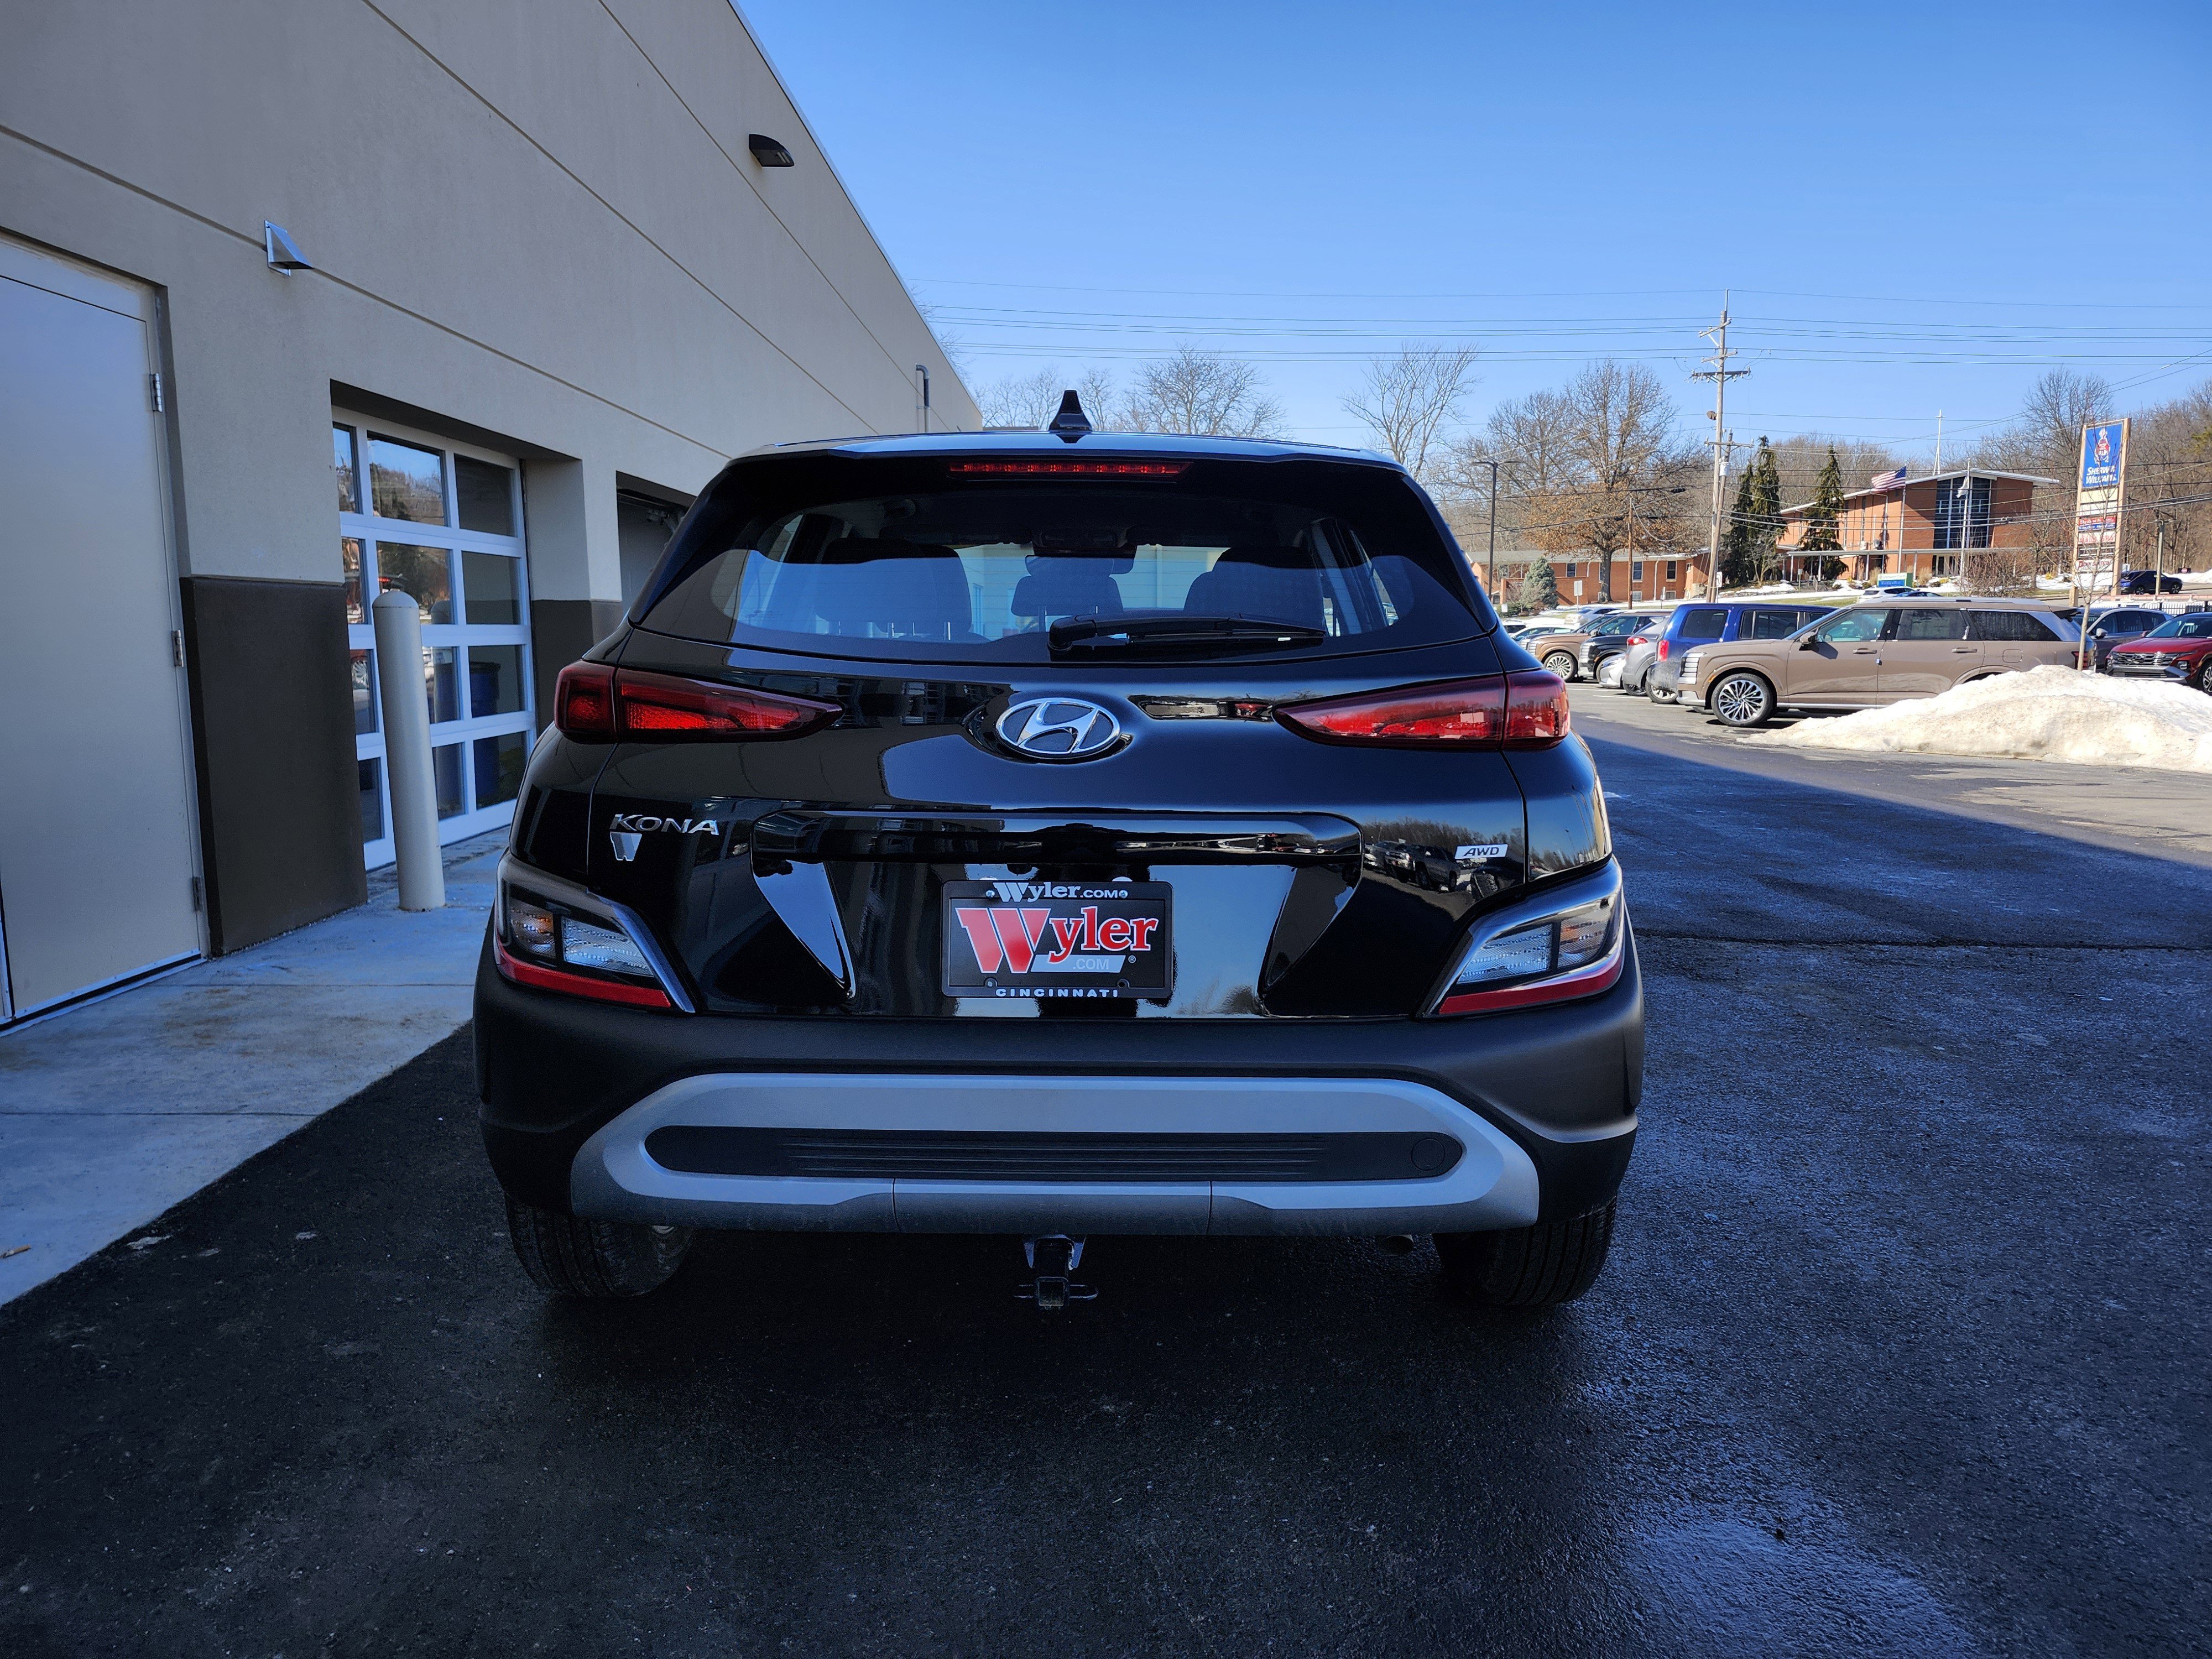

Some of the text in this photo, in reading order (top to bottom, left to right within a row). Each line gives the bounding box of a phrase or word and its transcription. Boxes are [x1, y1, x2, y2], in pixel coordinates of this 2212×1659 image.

[609, 813, 719, 836] KONA
[1462, 847, 1500, 857] AWD
[954, 906, 1159, 974] Wyler
[995, 988, 1118, 998] CINCINNATI
